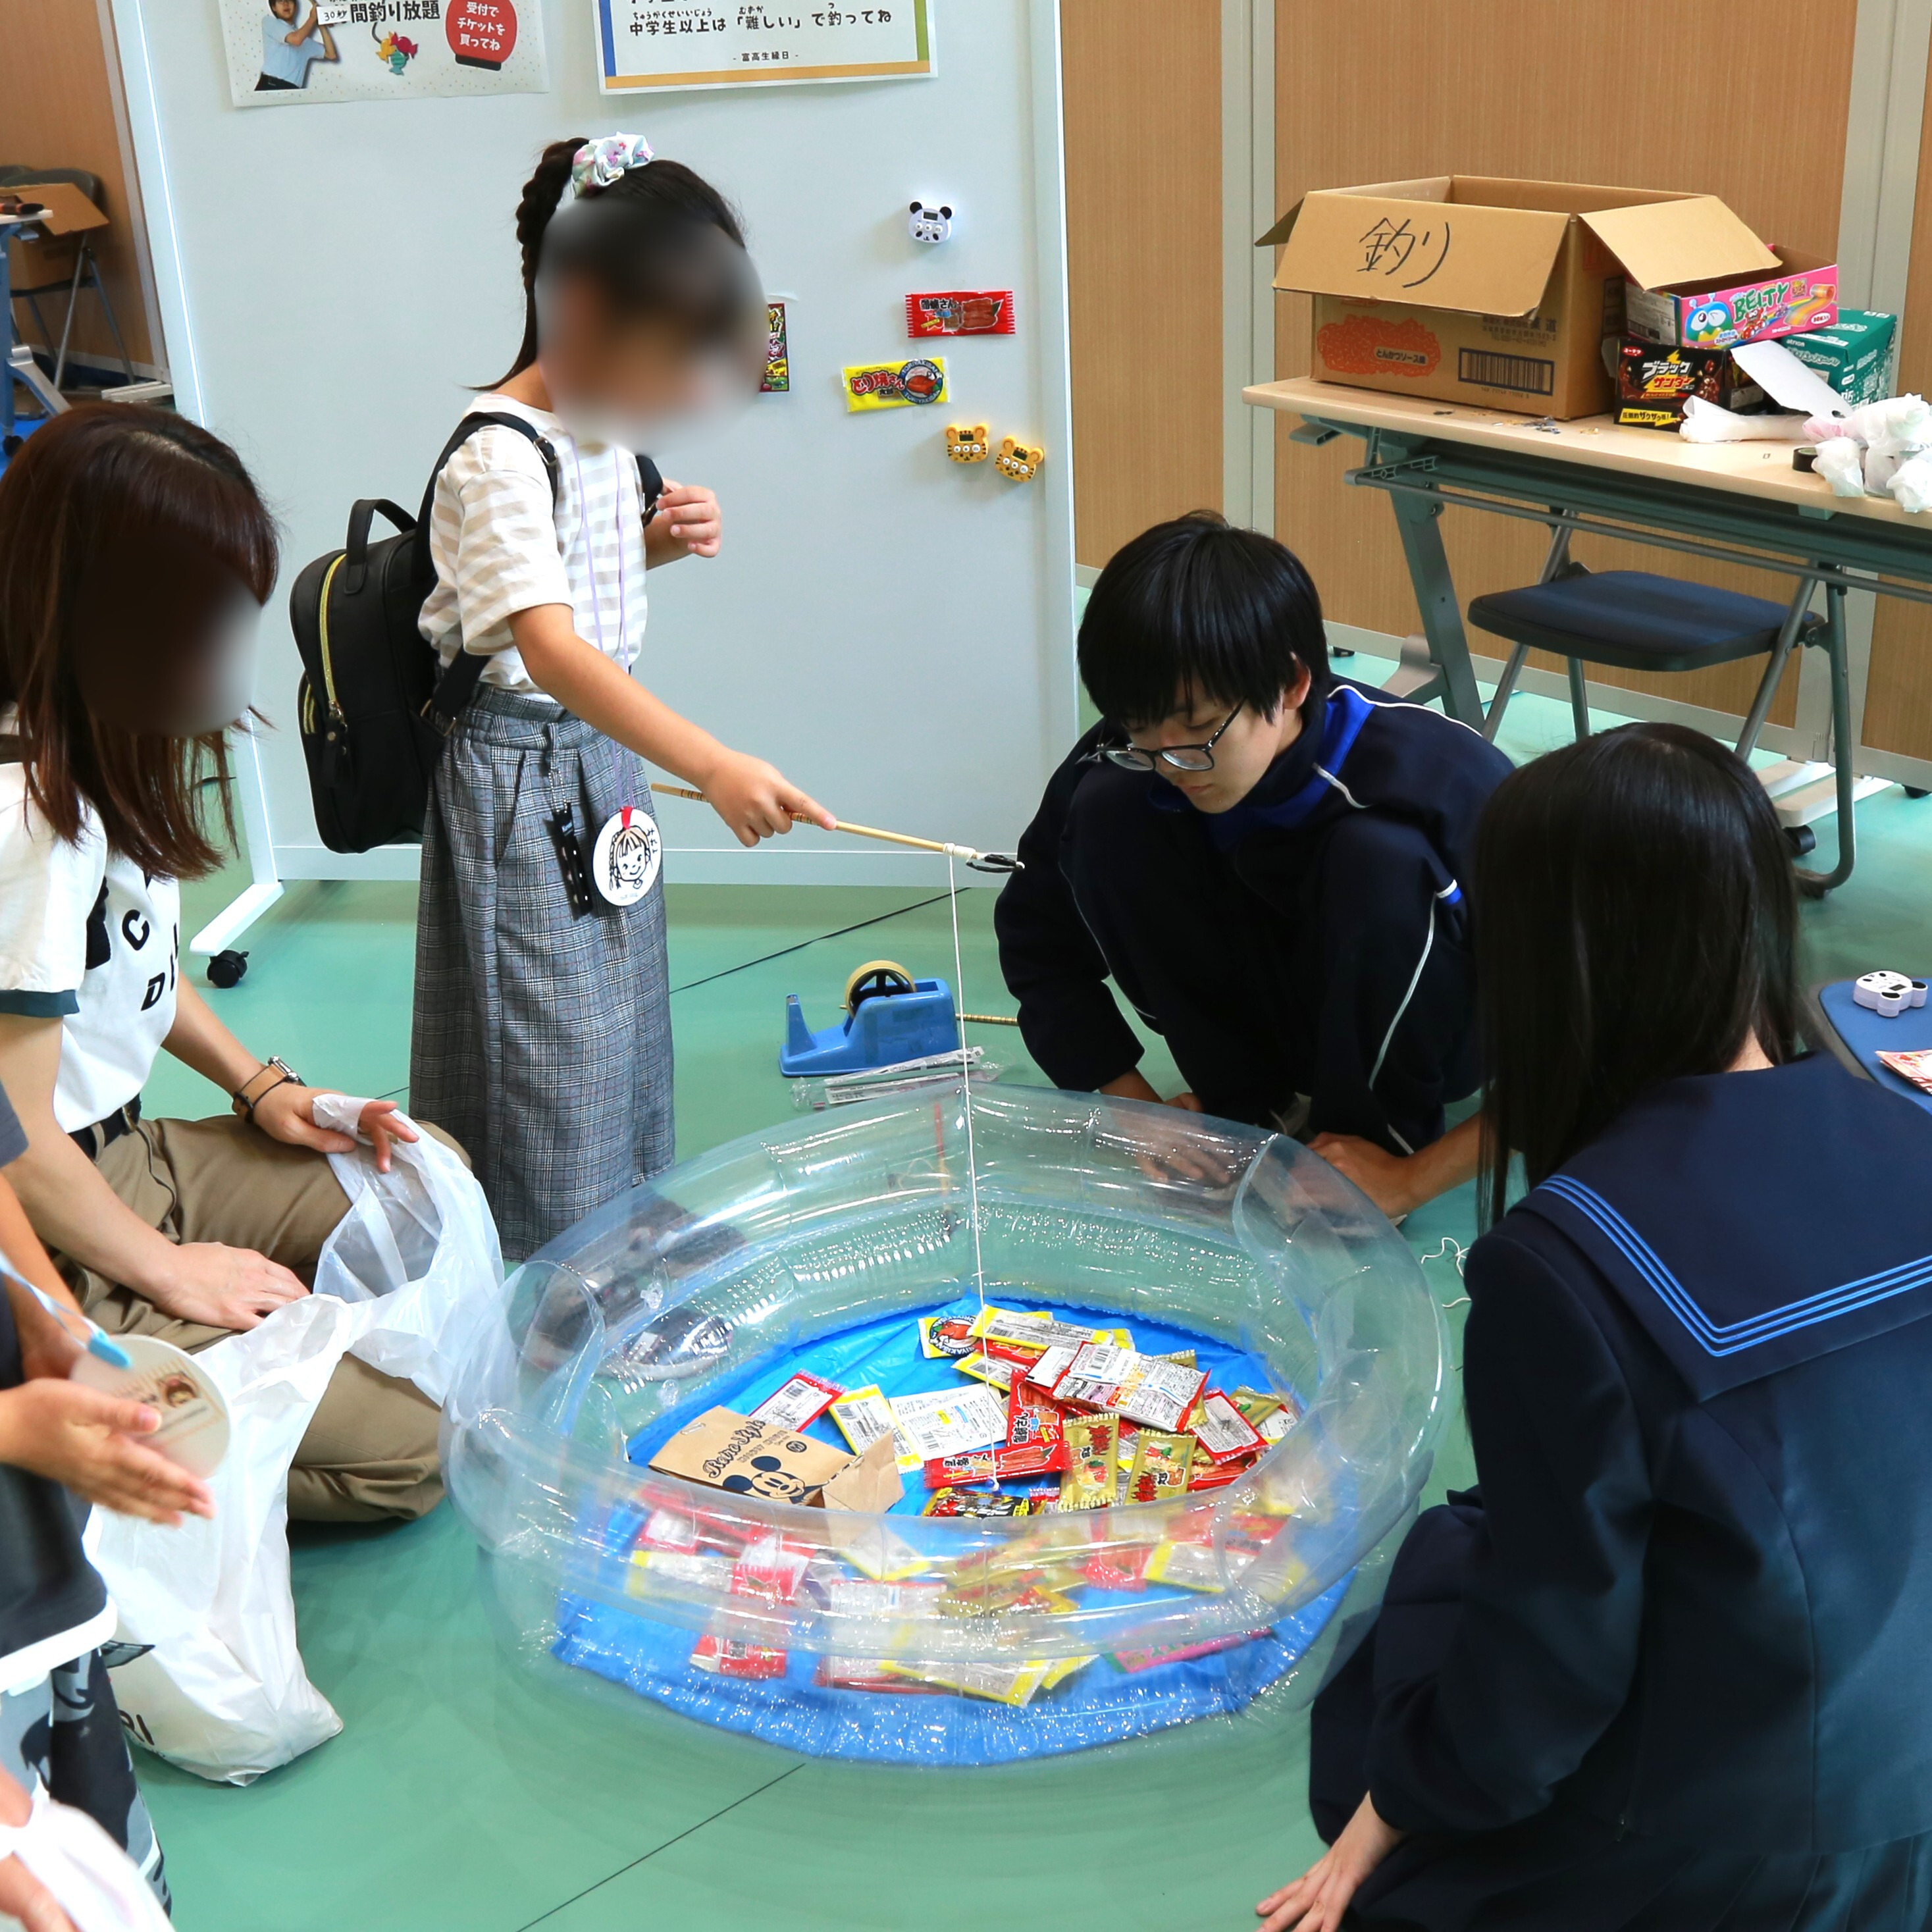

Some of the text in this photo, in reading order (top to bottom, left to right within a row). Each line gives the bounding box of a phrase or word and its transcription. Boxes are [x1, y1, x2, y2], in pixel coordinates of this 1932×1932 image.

[350, 0, 440, 23] 間釣り放題
[466, 1, 500, 17] 受付で
[633, 8, 712, 20] ちゅうがくせいいじょう
[739, 6, 764, 14] むずか
[457, 17, 506, 36] チケットを
[459, 33, 501, 51] 買ってね
[1357, 217, 1450, 288] 釣り
[1733, 282, 1789, 323] BELTY
[1642, 361, 1692, 382] ブラック
[1653, 376, 1695, 390] サンダー
[702, 1443, 742, 1478] Retro
